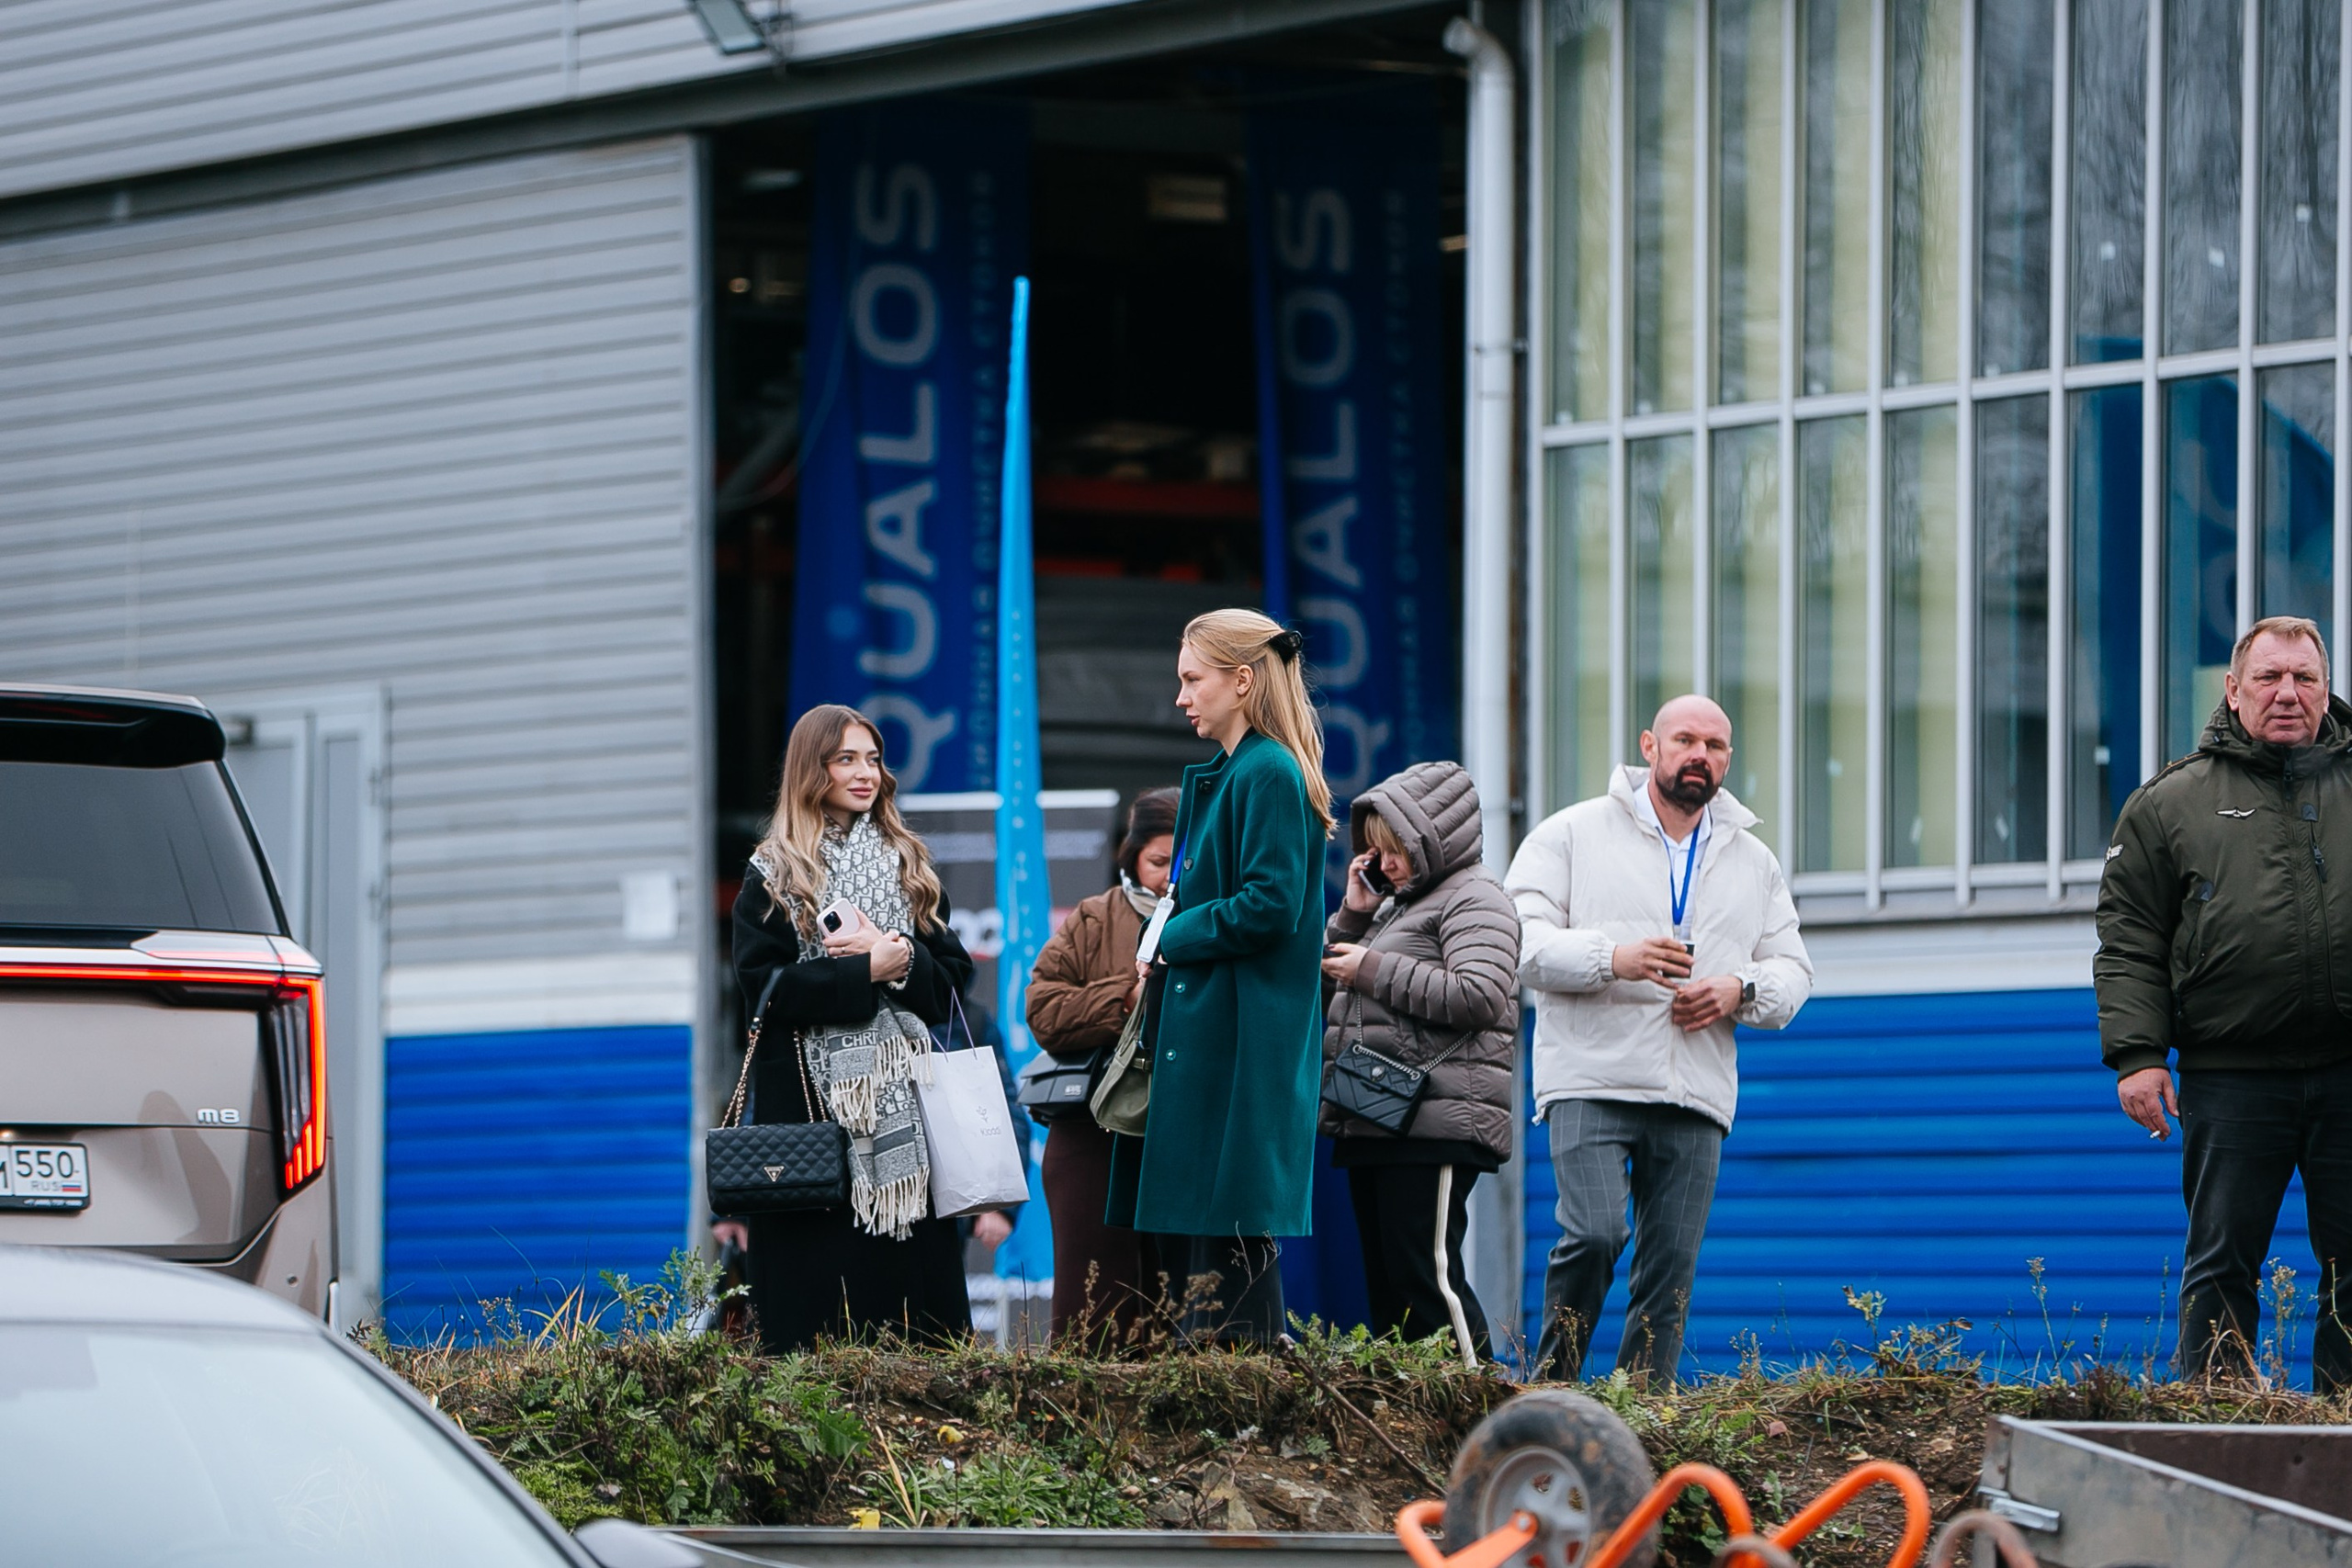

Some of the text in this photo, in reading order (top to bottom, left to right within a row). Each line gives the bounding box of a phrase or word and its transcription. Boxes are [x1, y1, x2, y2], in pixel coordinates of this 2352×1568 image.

[852, 162, 957, 789] QUALOS
[1274, 187, 1389, 791] QUALOS
[16, 1150, 74, 1179] 550
[842, 1032, 878, 1048] CHRI
